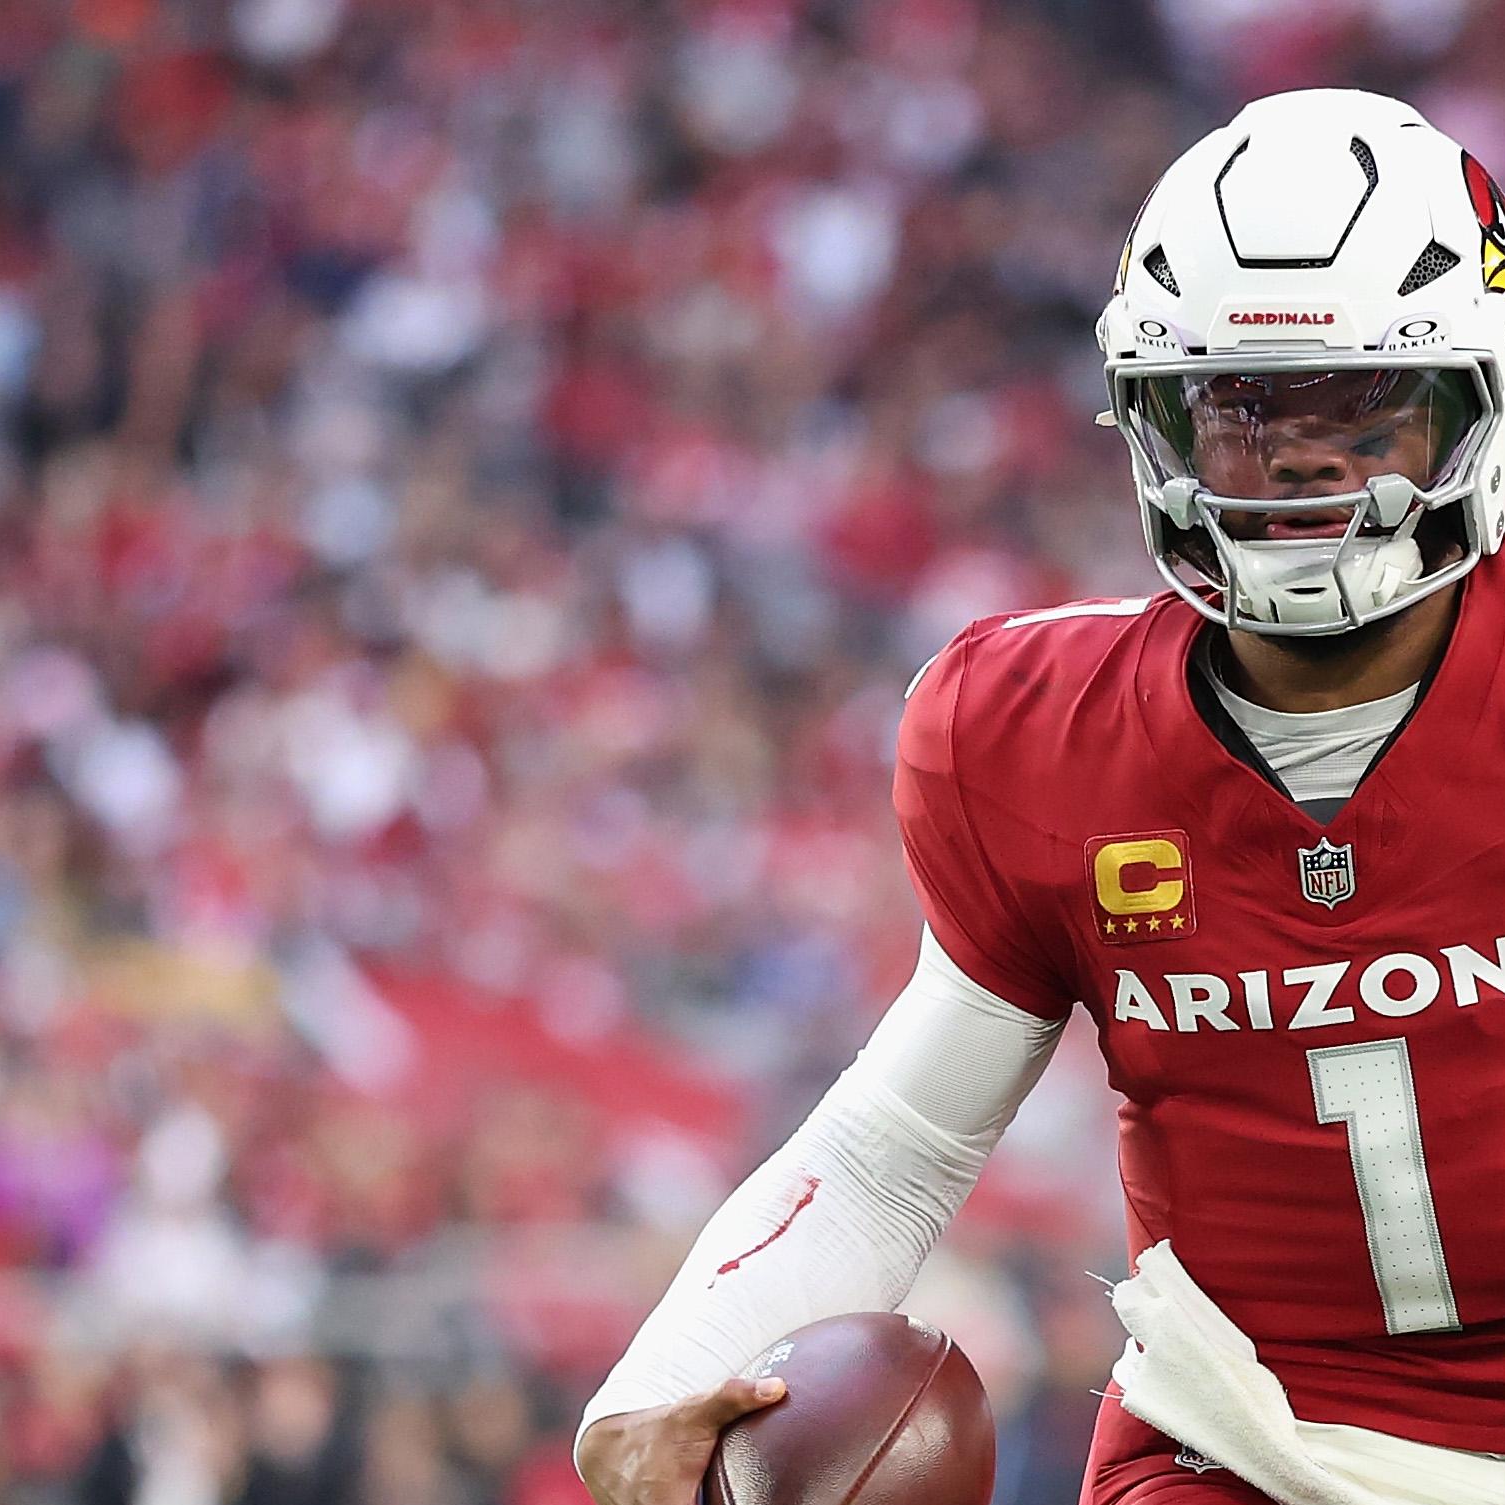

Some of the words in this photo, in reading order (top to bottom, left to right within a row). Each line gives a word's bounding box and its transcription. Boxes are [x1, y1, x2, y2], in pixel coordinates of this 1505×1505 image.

[1228, 312, 1335, 325] CARDINALS
[1136, 336, 1177, 349] OAKLEY
[1389, 336, 1446, 351] OAKLEY
[1095, 839, 1185, 915] C
[1309, 870, 1345, 897] NFL
[1306, 1037, 1463, 1335] 1
